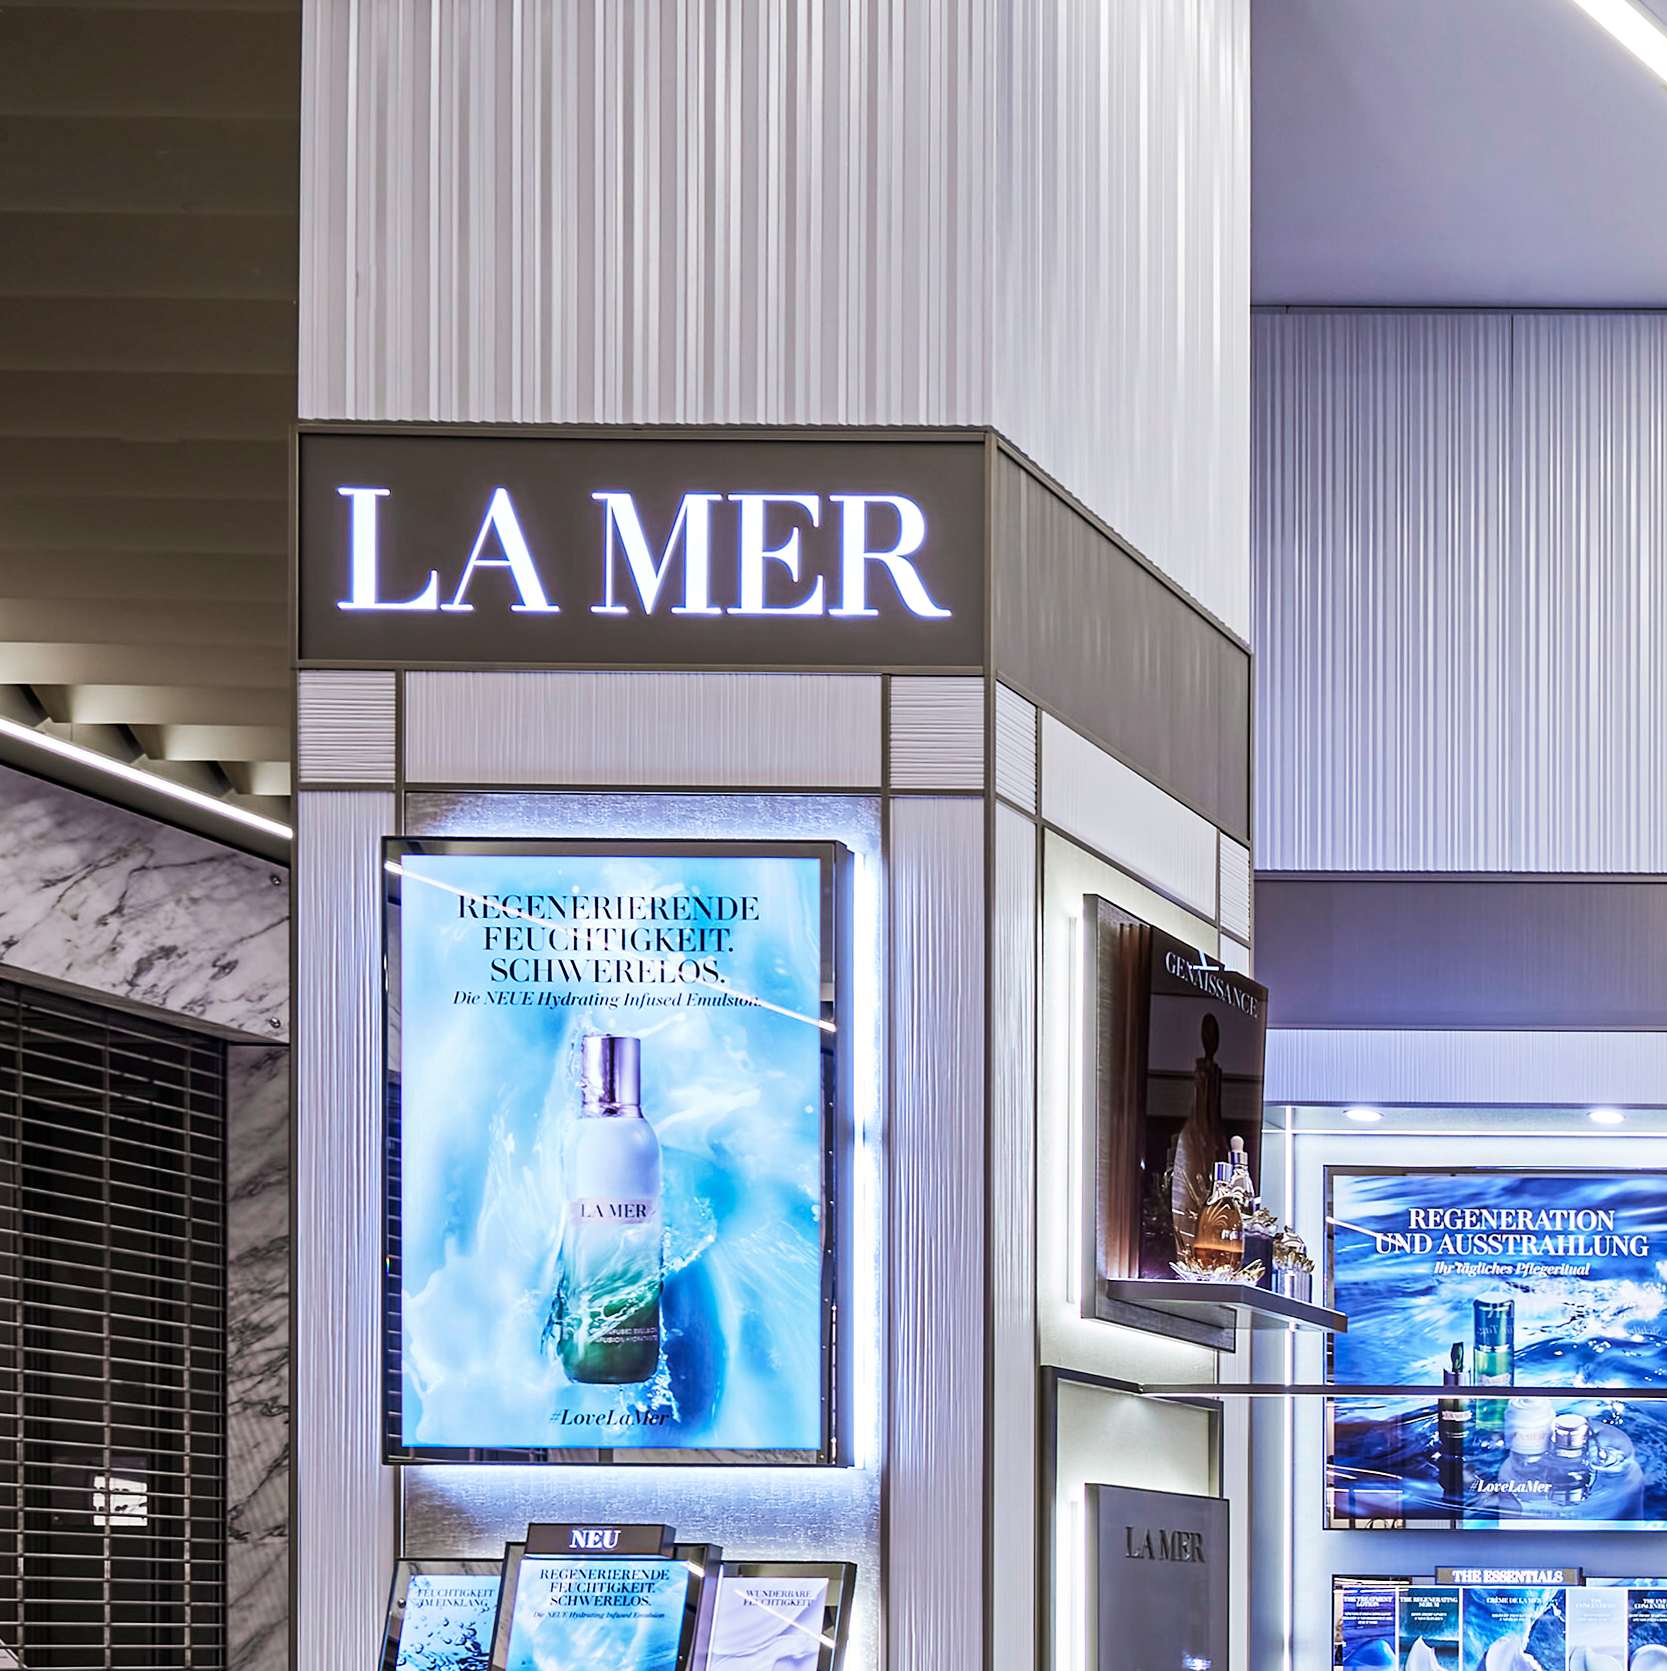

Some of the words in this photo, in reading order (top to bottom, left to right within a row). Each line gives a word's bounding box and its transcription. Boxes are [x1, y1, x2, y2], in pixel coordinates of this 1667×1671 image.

[337, 487, 560, 612] LA
[590, 492, 953, 618] MER
[457, 894, 760, 922] REGENERIERENDE
[483, 926, 734, 953] FEUCHTIGKEIT.
[490, 957, 726, 984] SCHWERELOS.
[1165, 951, 1258, 1019] GENAISSANCE
[453, 990, 481, 1006] Die
[483, 990, 534, 1006] NEUE
[537, 990, 620, 1009] Hydrating
[623, 991, 683, 1009] Infused
[580, 1203, 604, 1218] LA
[609, 1203, 648, 1218] MER
[1408, 1207, 1616, 1232] REGENERATION
[1375, 1233, 1433, 1256] UND
[1437, 1234, 1650, 1258] AUSSTRAHLUNG
[1433, 1261, 1453, 1275] Ihr
[1515, 1261, 1592, 1278] Pflegeritual
[549, 1408, 671, 1426] #LoveLaMer
[1469, 1480, 1553, 1494] #LoveLaMer
[568, 1529, 622, 1550] NEU
[1124, 1525, 1156, 1561] LA
[1158, 1528, 1206, 1564] MER
[540, 1568, 671, 1581] REGENERIERENDE
[1452, 1569, 1482, 1583] THE
[1483, 1569, 1564, 1583] ESSENTIALS
